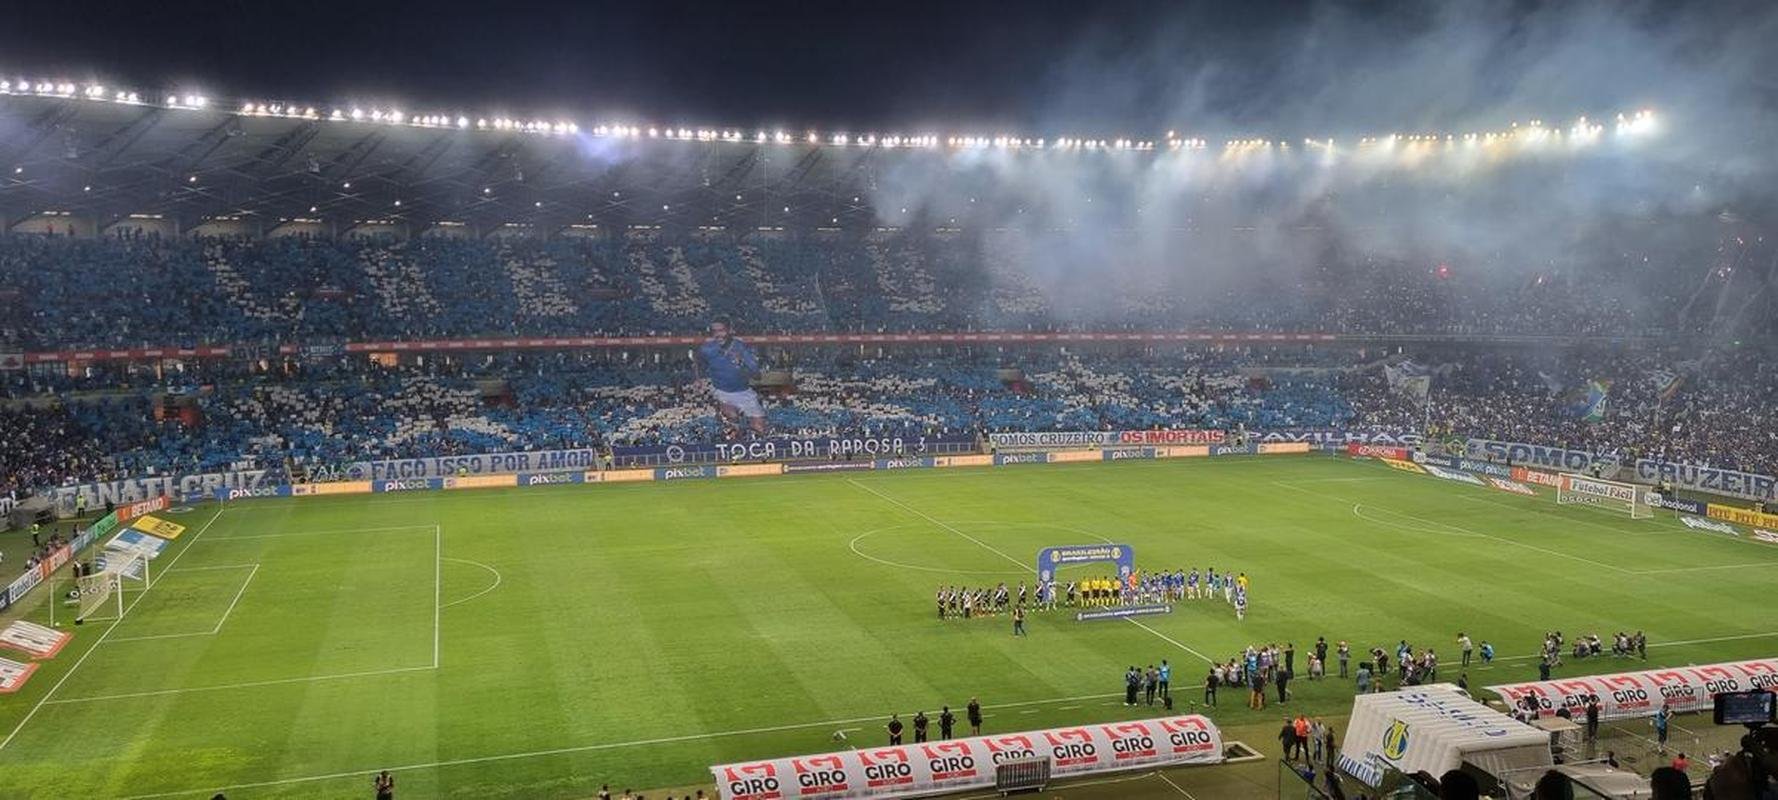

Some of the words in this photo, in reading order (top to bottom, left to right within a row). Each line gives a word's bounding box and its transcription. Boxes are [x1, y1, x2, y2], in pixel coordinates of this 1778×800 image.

[991, 433, 1036, 447] SOMOS
[1041, 432, 1104, 446] CRUZEIRO
[1121, 431, 1143, 443] OS
[1146, 430, 1224, 443] IMORTAIS
[715, 442, 775, 460] TOCA
[791, 440, 815, 457] DA
[830, 437, 903, 455] RAPOSA
[1112, 447, 1146, 460] pixbet
[436, 457, 482, 476] ISSO
[491, 455, 530, 472] POR
[537, 450, 592, 470] AMOR
[887, 454, 923, 469] pixbet
[1002, 452, 1038, 465] pixbet
[529, 473, 572, 486] pixbet
[665, 465, 705, 480] pixbet
[229, 485, 278, 500] pixbet
[384, 478, 430, 492] pixbet
[1572, 478, 1608, 496] Futebol
[131, 498, 165, 519] BETANO
[1660, 684, 1694, 699] GIRO
[1706, 679, 1739, 693] GIRO
[1613, 688, 1648, 703] GIRO
[1112, 736, 1155, 754] GIRO
[1170, 730, 1211, 747] GIRO
[1053, 742, 1096, 760] GIRO
[865, 762, 912, 781] GIRO
[929, 755, 975, 774] GIRO
[798, 769, 847, 788] GIRO
[730, 777, 780, 796] GIRO
